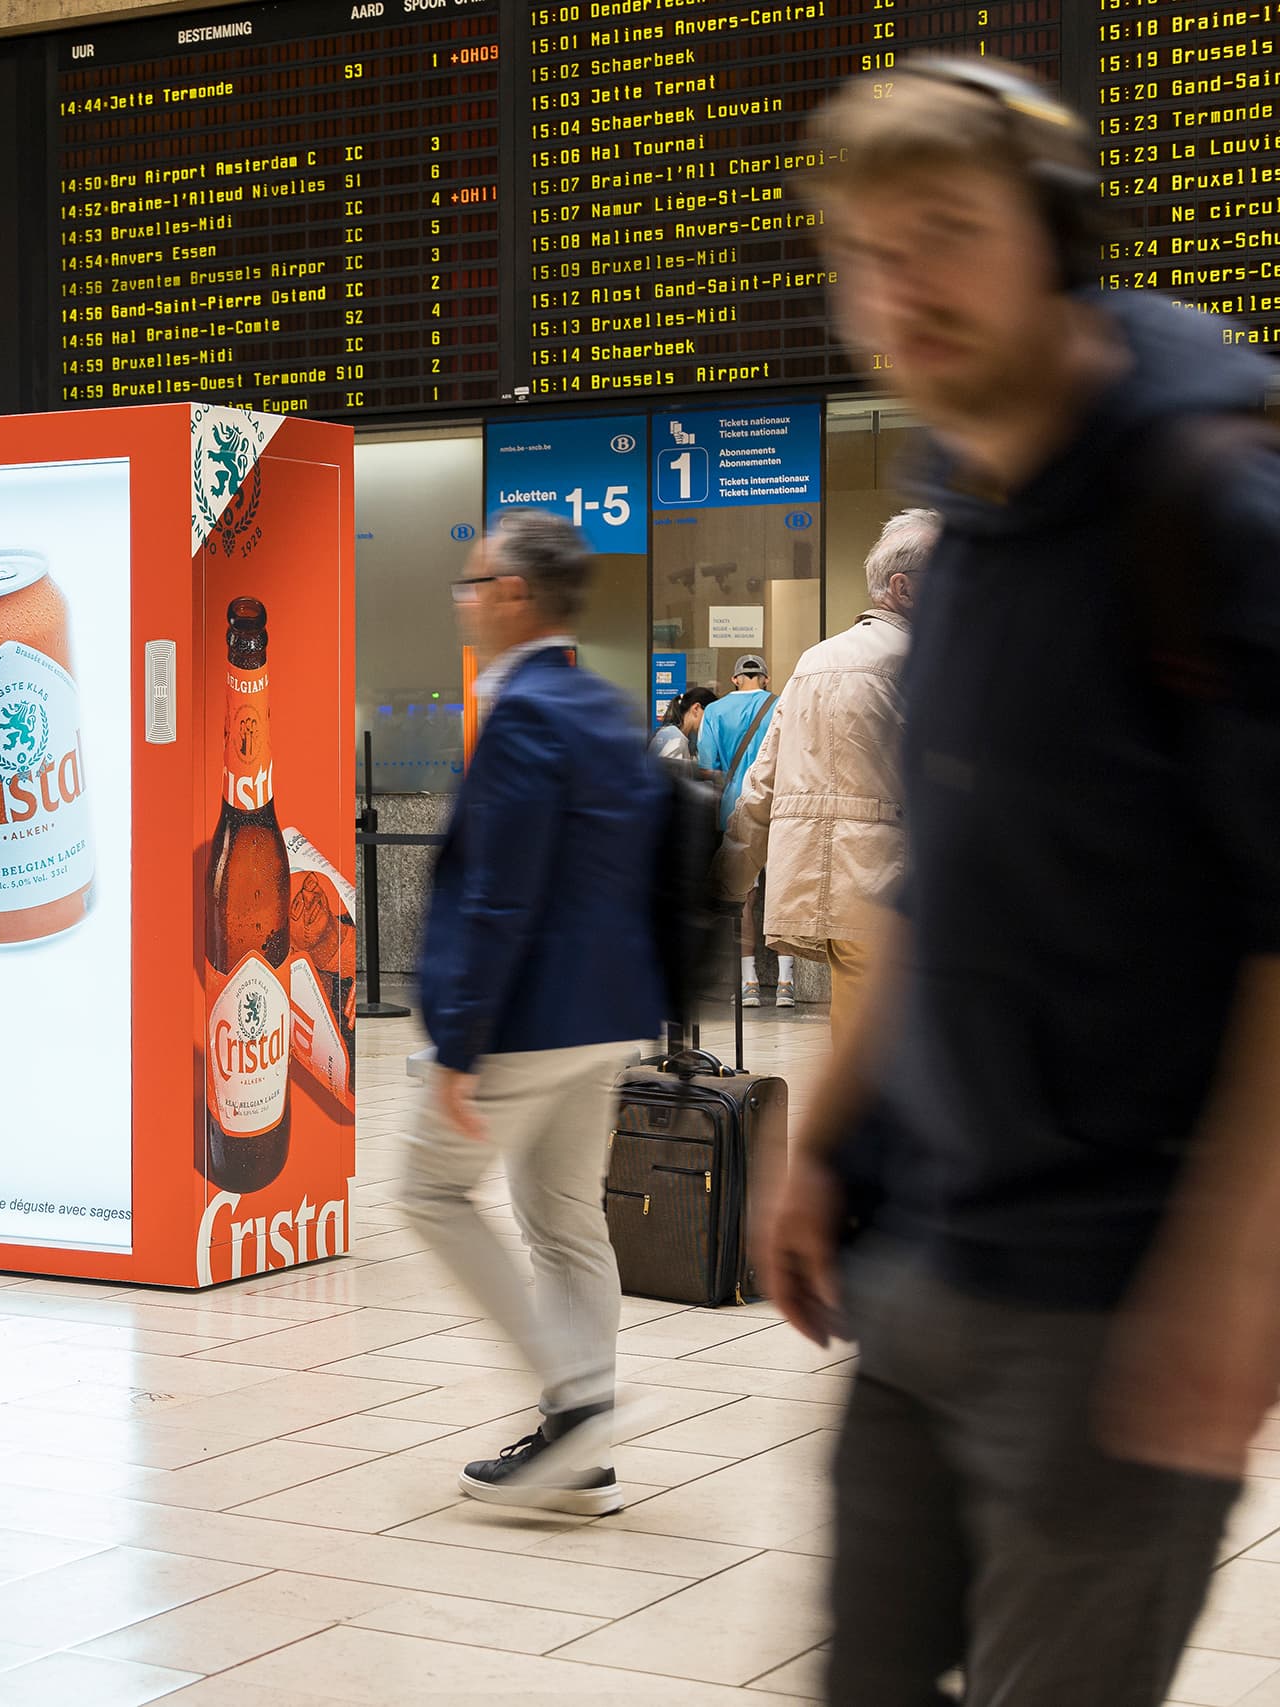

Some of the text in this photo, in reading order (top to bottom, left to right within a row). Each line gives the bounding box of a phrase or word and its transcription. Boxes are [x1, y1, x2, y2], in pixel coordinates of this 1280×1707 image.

[72, 2, 384, 59] UUR BESTEMMING AARD
[531, 5, 579, 26] 15:00
[532, 34, 577, 55] 15:01
[591, 26, 664, 47] Malines
[675, 1, 825, 36] Anvers-Central
[1099, 19, 1158, 42] 15:18
[532, 9, 988, 83] 15:02 Schaerbeek IC 3
[1100, 39, 1273, 73] 15:19 Brussels
[60, 97, 102, 116] 14:44
[110, 92, 154, 110] Jette
[162, 81, 233, 103] Termonde
[344, 63, 363, 79] S3
[532, 52, 895, 111] 15:03 Jette Ternat S10
[1100, 82, 1158, 105] 15:20
[532, 119, 580, 140] 15:04
[591, 106, 695, 133] Schaerbeek
[707, 97, 782, 119] Louvain
[1100, 102, 1273, 135] 15:23 Termonde
[61, 136, 440, 194] 14:50 Bru Airport Amsterdam C IC 3
[532, 134, 705, 168] 15:06 Hal Tournai
[1100, 143, 1195, 167] 15:23 La
[61, 164, 440, 220] 14:52 Braine-l'Alleud Nivelles S1 6
[532, 176, 580, 196] 15:07
[591, 162, 715, 190] Braine-l'All
[1100, 167, 1280, 197] 15:24 Bruxelles
[62, 191, 440, 245] 14:53 Bruxelles-Midi IC 4
[532, 205, 580, 224] 15:07
[591, 201, 643, 218] Namur
[1171, 205, 1195, 223] Ne
[62, 219, 440, 271] 14:54 Anvers Essen IC 5
[532, 209, 825, 252] 15:08 Malines Anvers-Central
[532, 247, 737, 281] 15:09 Bruxelles-Midi
[1101, 239, 1158, 259] 15:24
[62, 247, 440, 297] 14:56 Zaventem Brussels Airpor IC 3
[1100, 271, 1157, 289] 15:24
[62, 275, 440, 323] 14:56 Gand-Saint-Pierre Ostend IC 2
[532, 271, 838, 309] 15:12 Alost Gand-Saint-Pierre
[62, 302, 440, 349] 14:56 Hal Braine-le-Comte S2 4
[532, 306, 737, 337] 15:13 Bruxelles-Midi
[63, 330, 440, 375] 14:59 Bruxelles-Midi IC 6
[532, 338, 695, 365] 15:14 Schaerbeek
[63, 358, 441, 401] 14:59 Bruxelles-Ouest Termonde S10 2
[532, 362, 769, 394] 15:14 Brussels Airport
[263, 398, 308, 415] Eupen
[346, 391, 364, 407] IC
[719, 415, 791, 428] Tickets nationaux
[719, 426, 788, 439] Tickets nationaal
[719, 446, 776, 457] Abonnements
[719, 457, 782, 468] Abonnementen
[670, 452, 691, 499] 1
[719, 474, 810, 486] Tickets internationaux
[719, 485, 807, 497] Tickets internationaal
[500, 485, 631, 526] Loketten 1-5
[241, 526, 263, 559] 1928
[26, 682, 50, 702] KLAS
[10, 824, 50, 841] ALKEN
[2, 855, 55, 877] BELGIAN
[57, 840, 87, 863] LAGER
[215, 1014, 285, 1082] Cristal
[10, 1198, 56, 1214] déguste
[58, 1204, 87, 1217] avec
